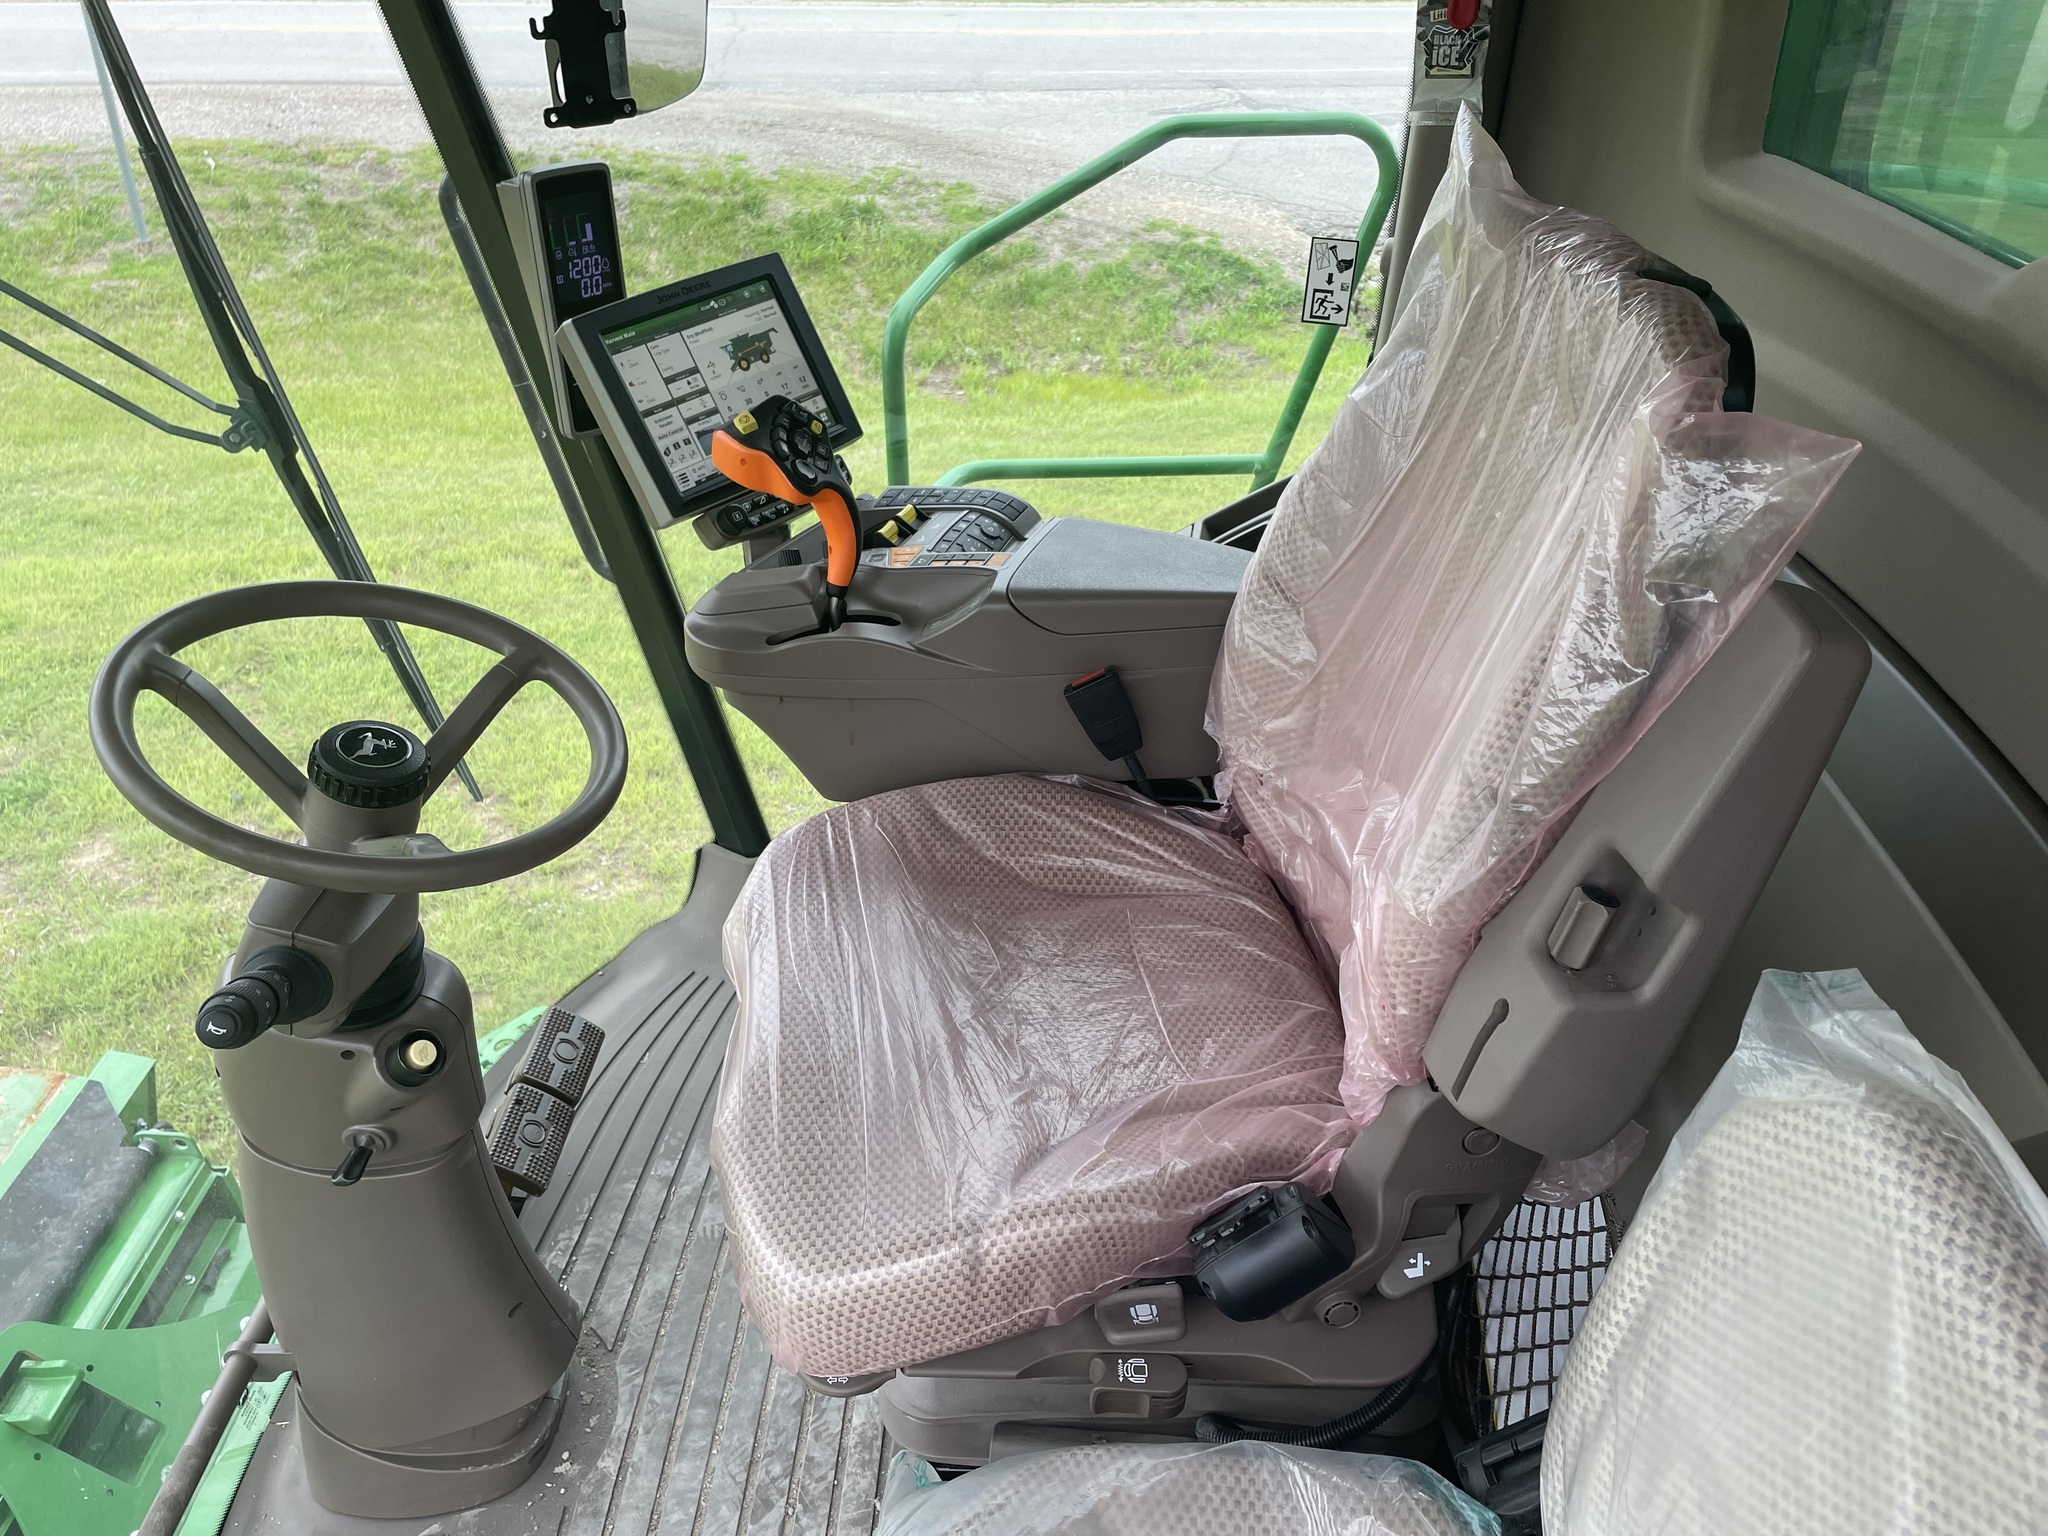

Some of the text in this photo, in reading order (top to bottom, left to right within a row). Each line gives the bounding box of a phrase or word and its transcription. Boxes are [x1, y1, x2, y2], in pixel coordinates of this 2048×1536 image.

[1433, 34, 1461, 45] BLACK
[569, 254, 602, 279] 1200
[581, 275, 603, 298] 0.0
[657, 280, 712, 305] JOHN DEERE
[605, 330, 636, 345] Harvest Main
[799, 375, 807, 383] 12
[781, 382, 789, 391] 17
[744, 397, 753, 406] 30
[654, 414, 673, 424] Unknown
[659, 420, 674, 429] Header
[668, 426, 684, 437] Control
